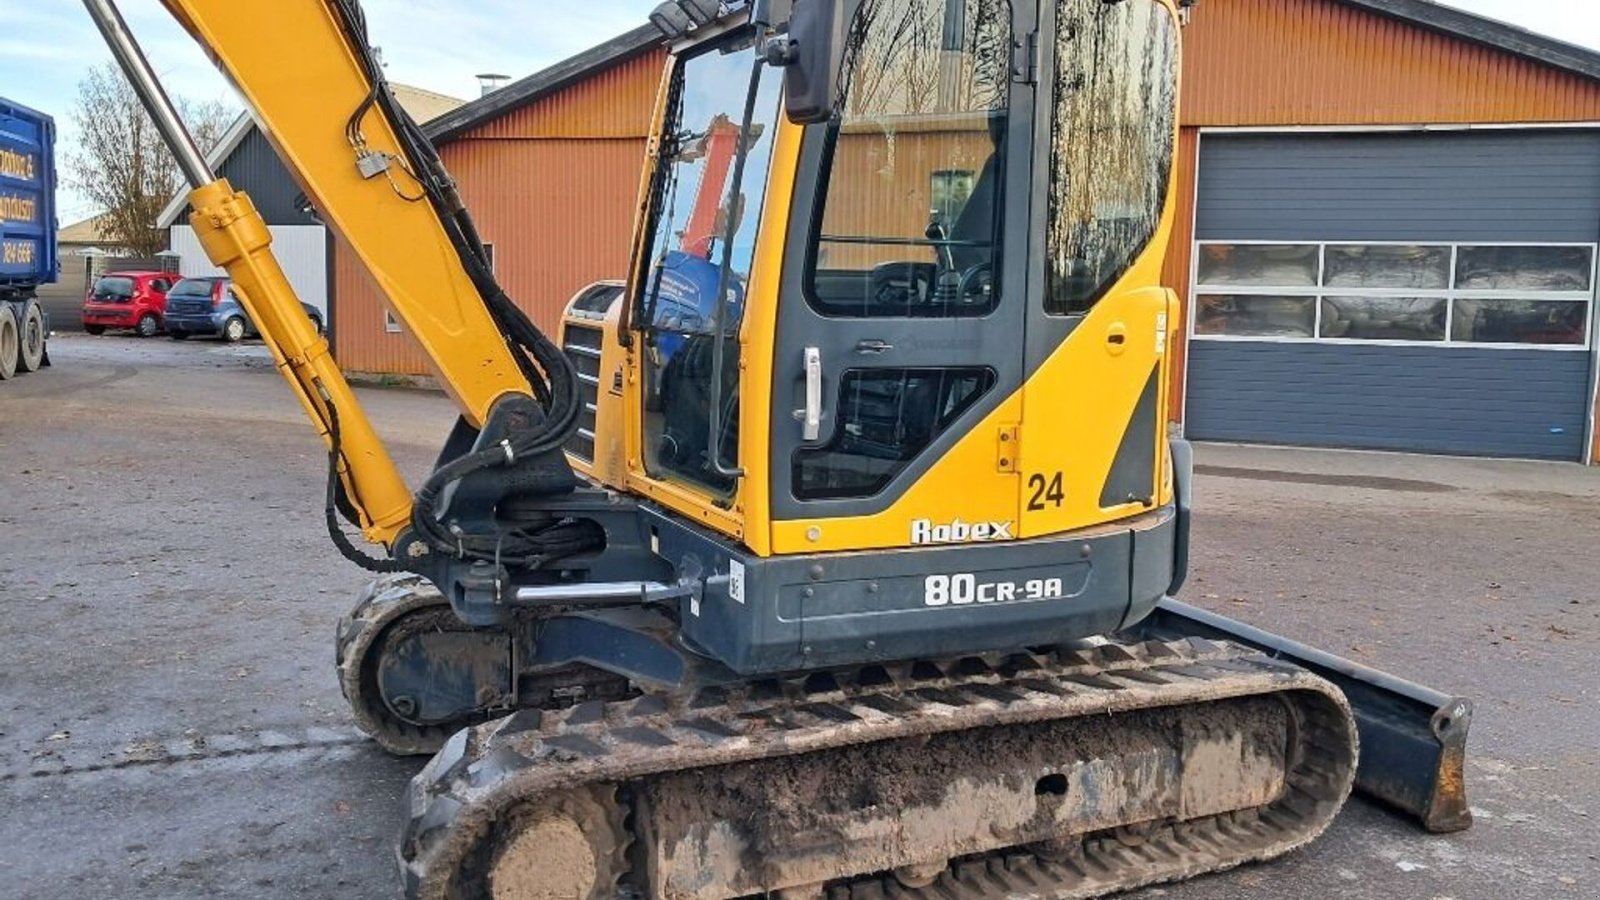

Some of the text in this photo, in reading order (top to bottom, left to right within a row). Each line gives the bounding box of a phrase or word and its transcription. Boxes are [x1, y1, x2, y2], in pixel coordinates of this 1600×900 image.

[1027, 471, 1065, 511] 24
[910, 516, 1016, 543] Robex
[924, 573, 1063, 606] 80CR-9A
